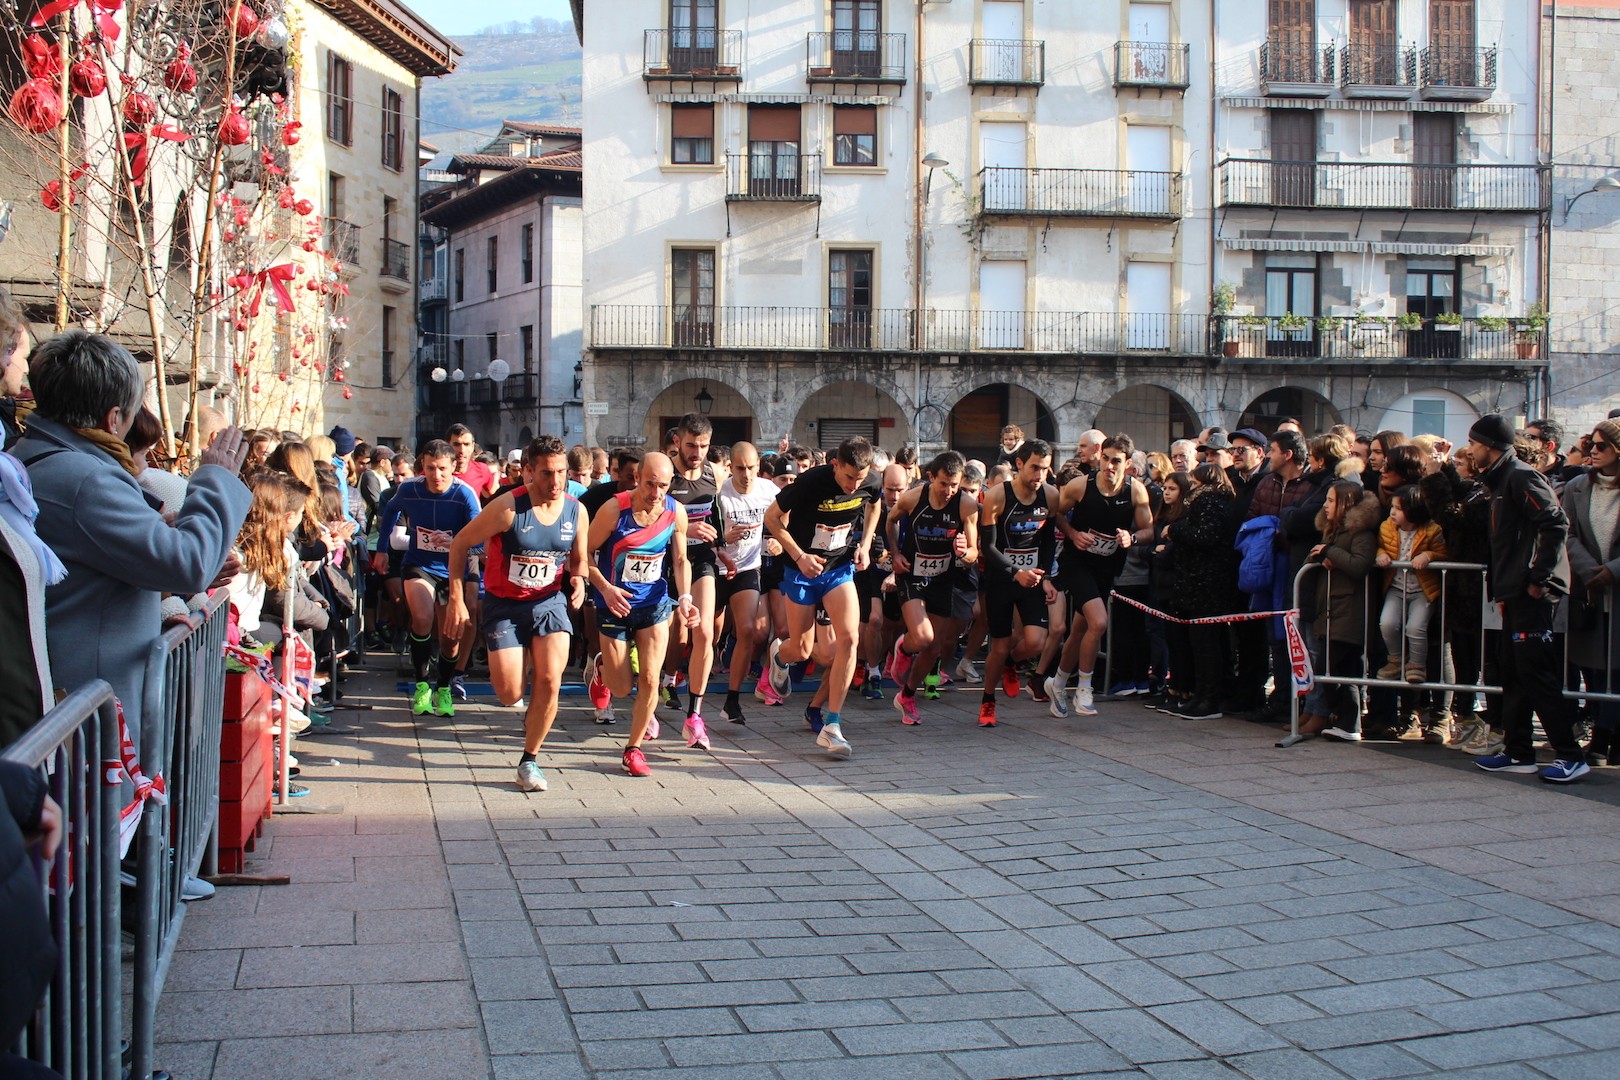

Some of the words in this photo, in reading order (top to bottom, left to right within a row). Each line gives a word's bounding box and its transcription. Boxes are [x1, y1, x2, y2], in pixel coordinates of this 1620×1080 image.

[1093, 536, 1117, 550] 572
[630, 560, 659, 574] 475
[919, 559, 945, 570] 441
[1009, 554, 1034, 566] 335
[517, 562, 549, 579] 701
